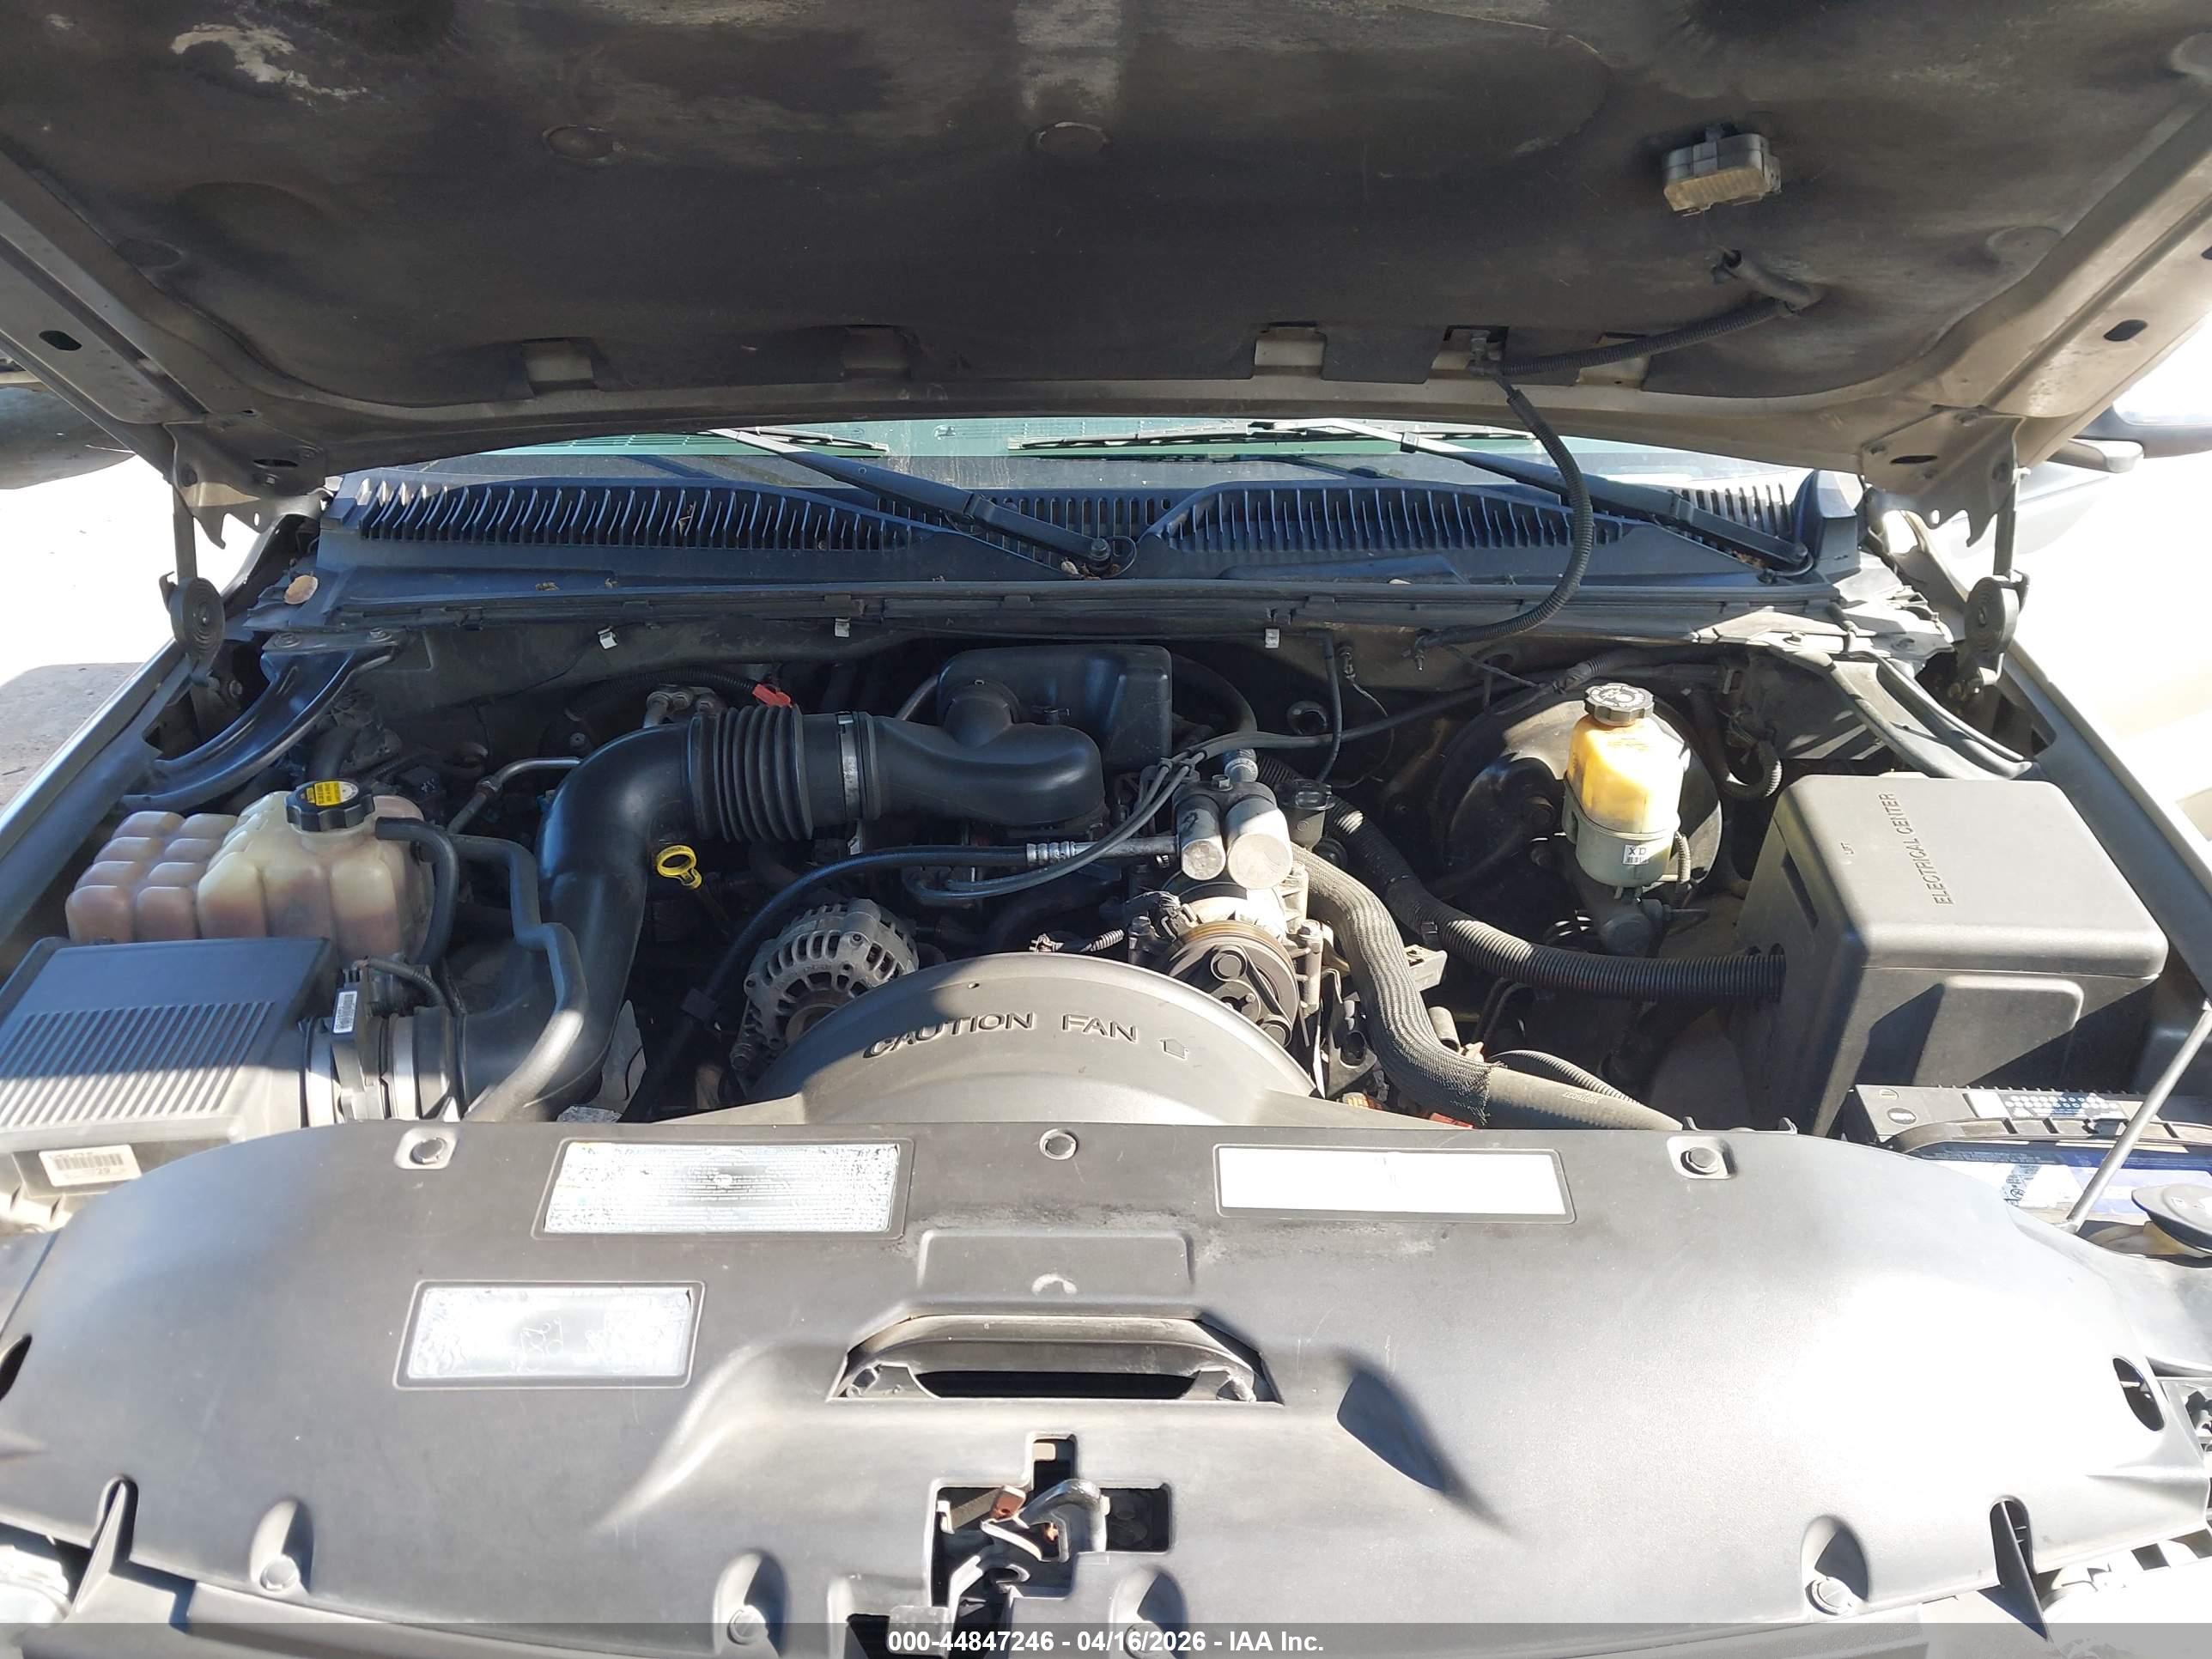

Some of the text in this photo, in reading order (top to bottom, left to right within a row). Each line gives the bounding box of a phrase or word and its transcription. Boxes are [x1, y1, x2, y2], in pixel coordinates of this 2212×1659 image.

[1878, 793, 1954, 905] ELECTRICAL CENTER
[862, 1012, 1138, 1059] CAUTION FAN
